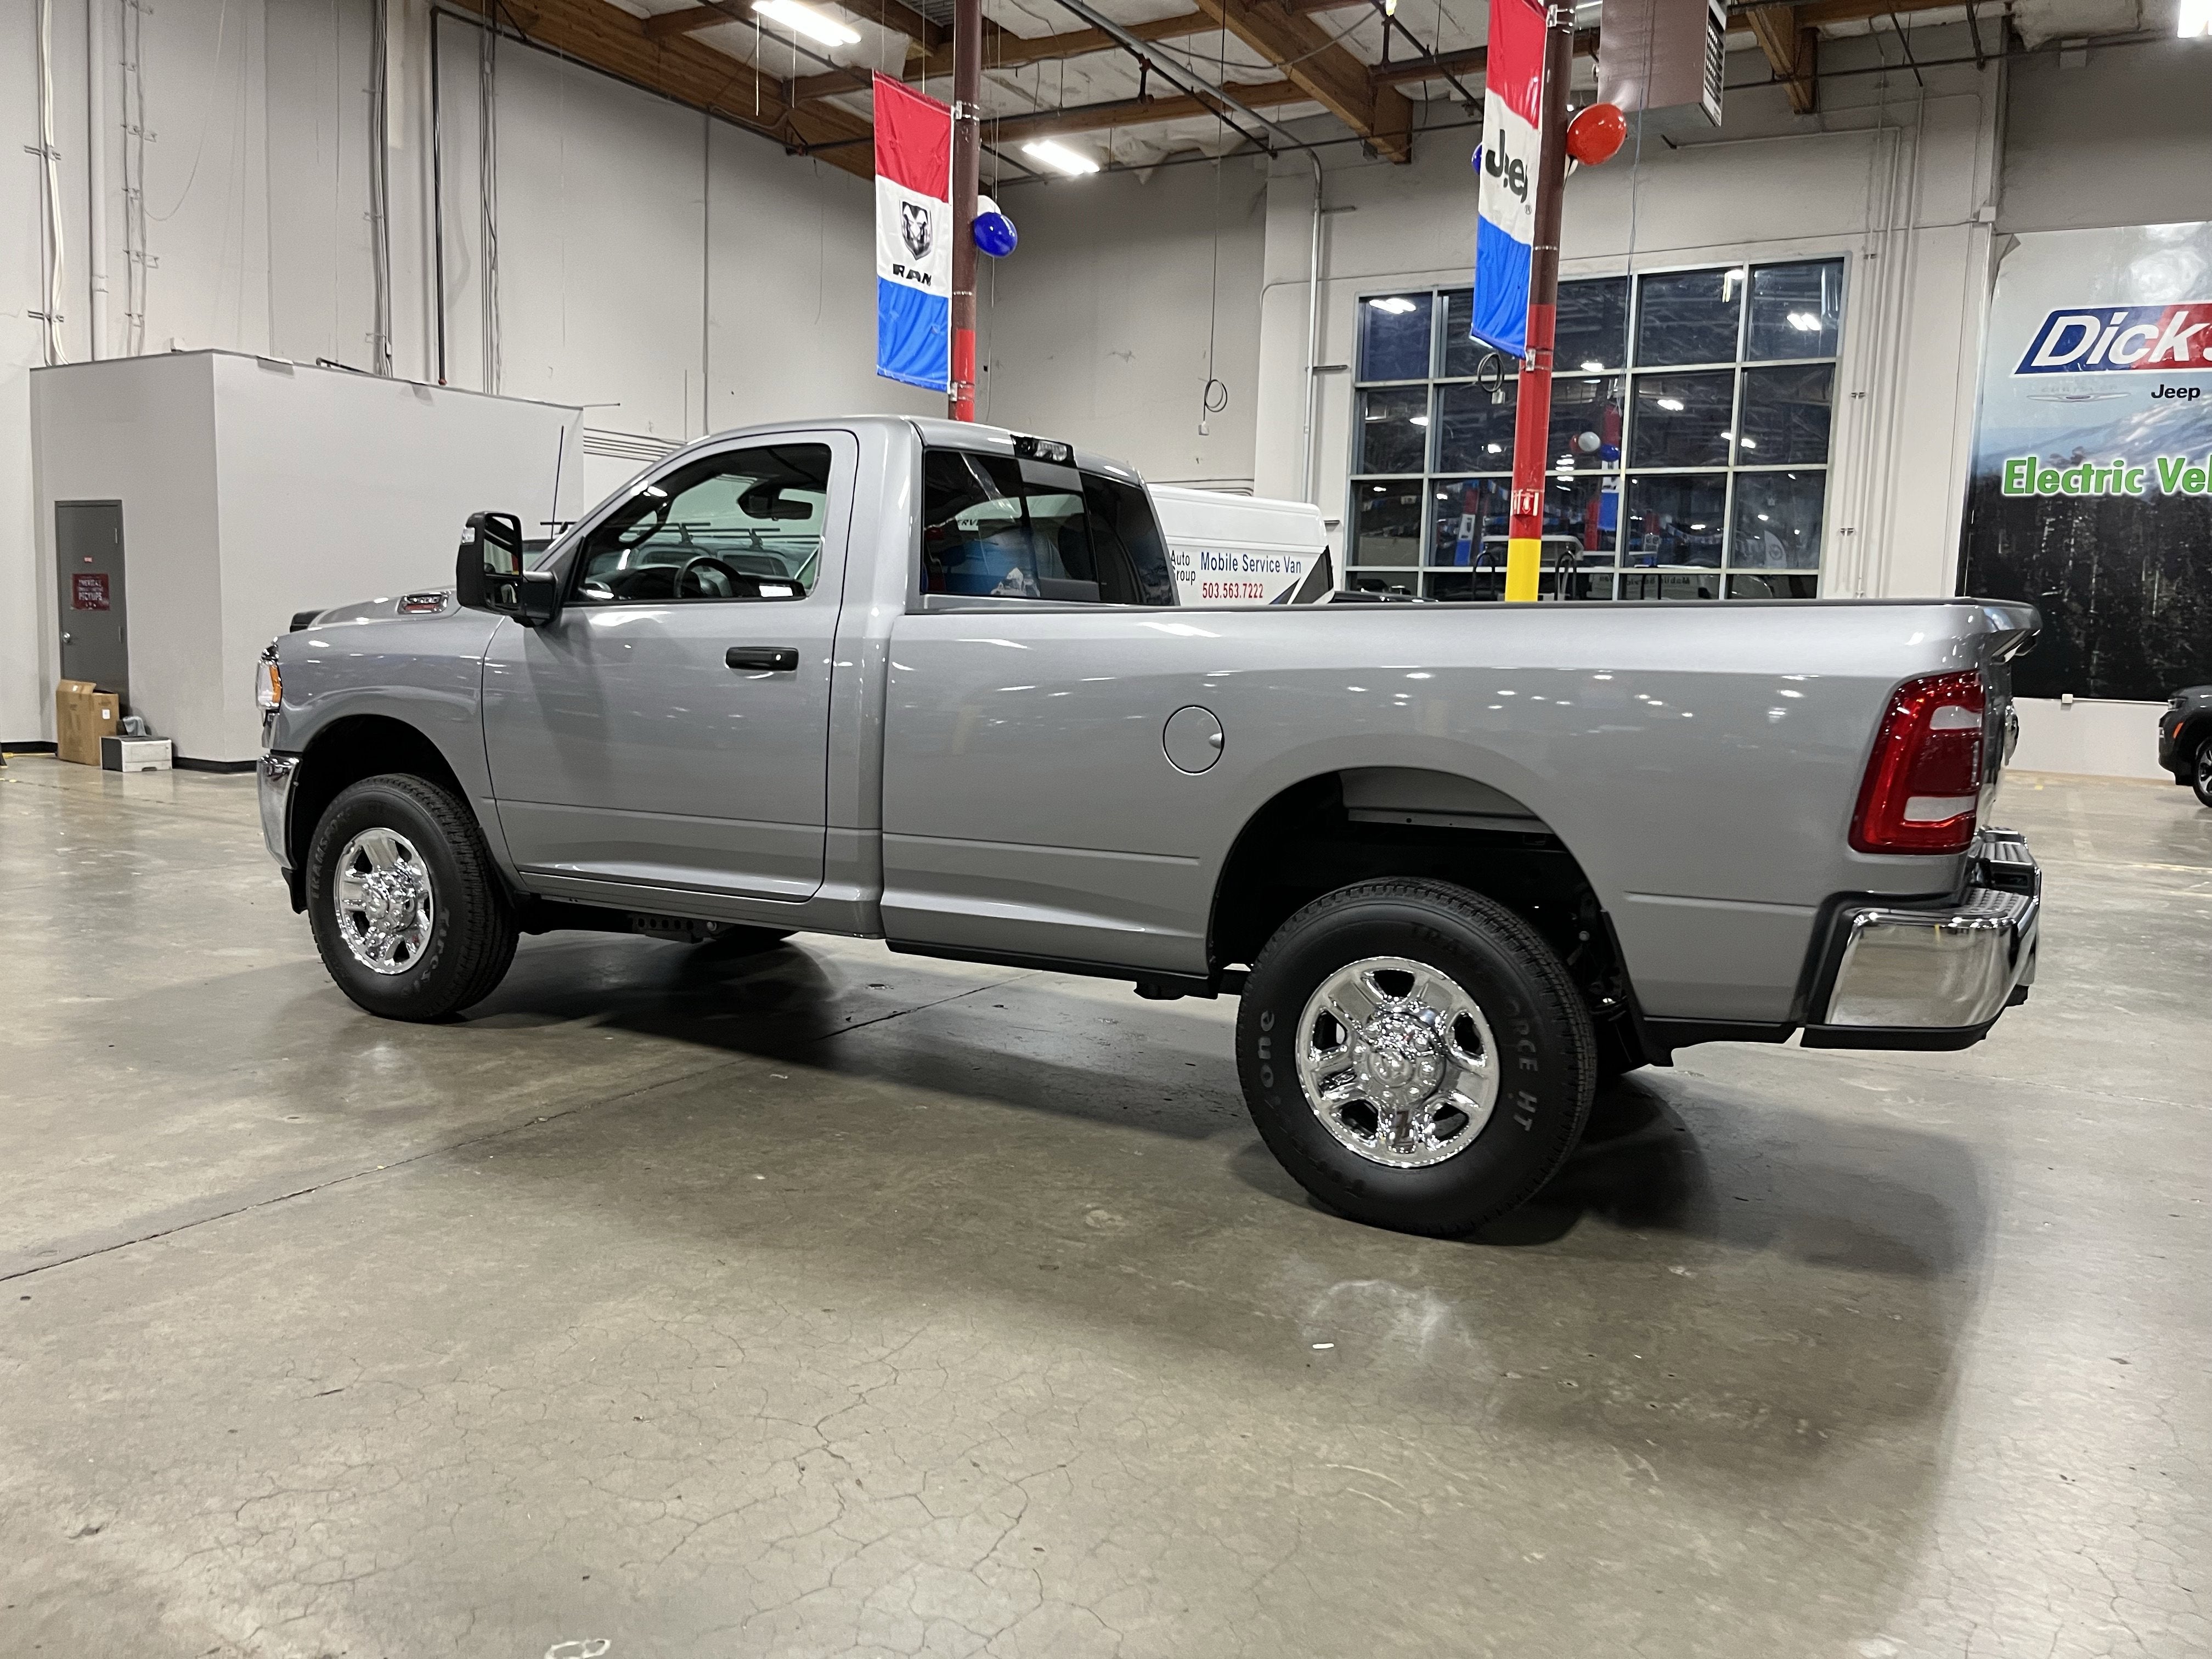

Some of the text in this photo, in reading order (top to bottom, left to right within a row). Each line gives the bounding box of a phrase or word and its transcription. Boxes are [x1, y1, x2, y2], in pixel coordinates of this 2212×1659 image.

[2030, 311, 2212, 367] Dick
[2151, 384, 2200, 401] Jeep
[2004, 454, 2212, 494] Electric Ve
[1171, 550, 1190, 566] Auto
[1200, 551, 1301, 574] Mobile Service Van
[1173, 566, 1196, 586] roup
[1202, 582, 1263, 599] 503.563.7222
[1513, 1090, 1538, 1132] HT
